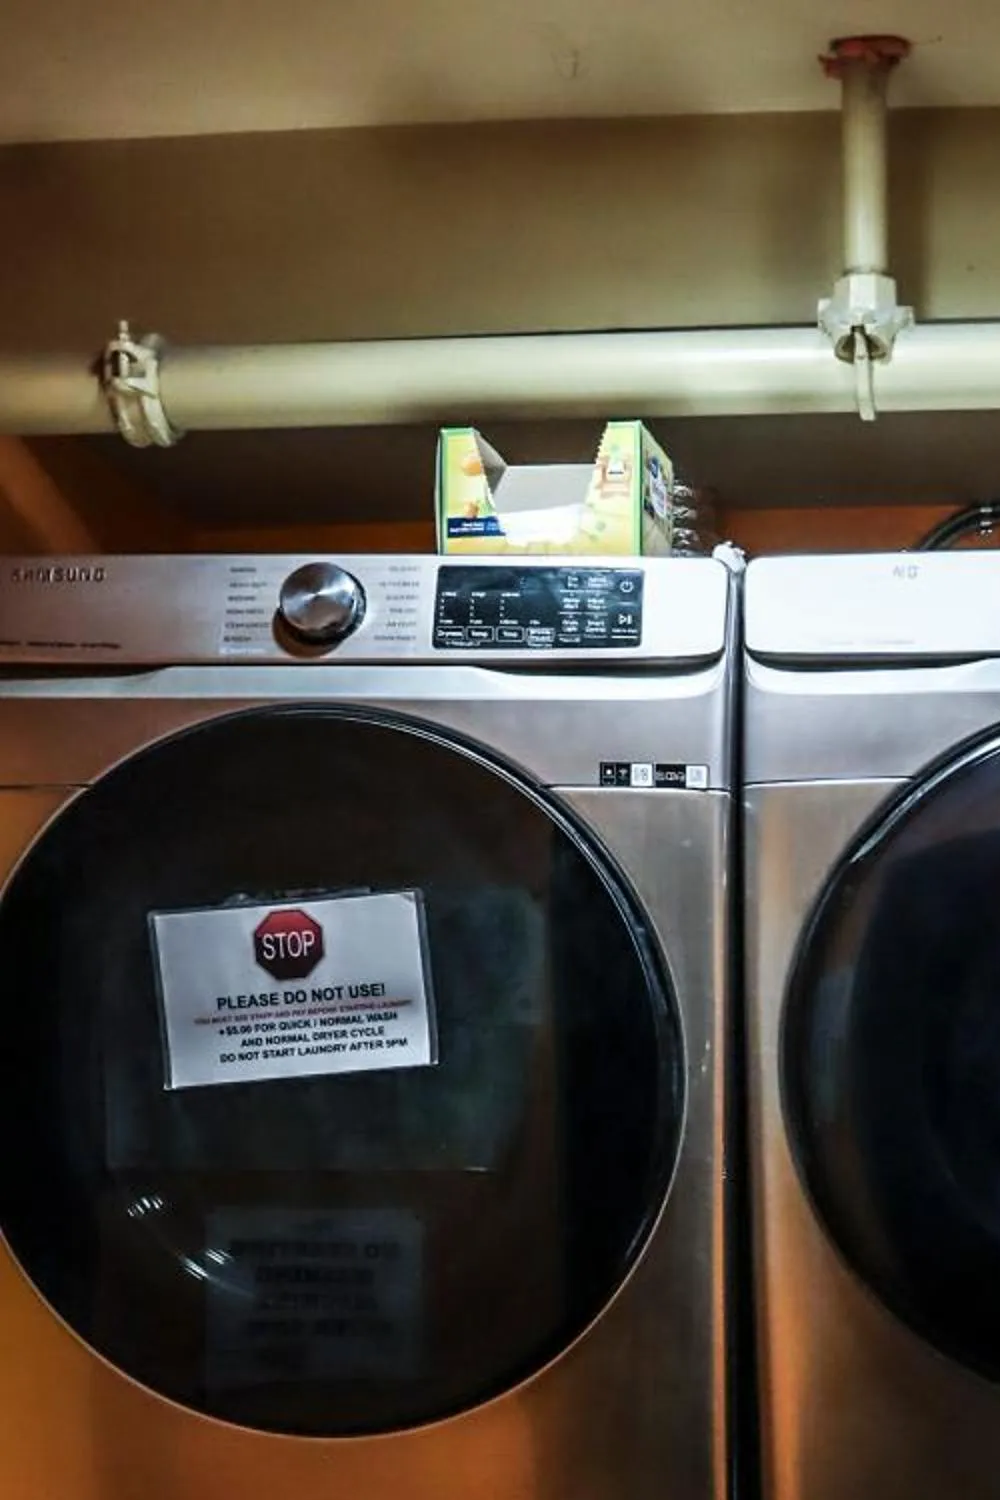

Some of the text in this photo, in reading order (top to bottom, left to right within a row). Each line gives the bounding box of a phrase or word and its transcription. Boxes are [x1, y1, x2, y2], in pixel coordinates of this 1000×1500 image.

[262, 931, 315, 960] STOP
[217, 983, 386, 1010] PLEASE DO NOT USE!
[254, 1023, 275, 1033] FOR
[278, 1019, 310, 1031] QUICK
[319, 1015, 364, 1027] NORMAL
[367, 1011, 398, 1022] WASH
[240, 1026, 385, 1048] AND NORMAL DRYER CYCLE
[220, 1053, 236, 1064] DO
[238, 1051, 259, 1062] NOT
[262, 1047, 295, 1060] START
[297, 1043, 348, 1057] LAUNDRY
[349, 1040, 384, 1051] AFTER
